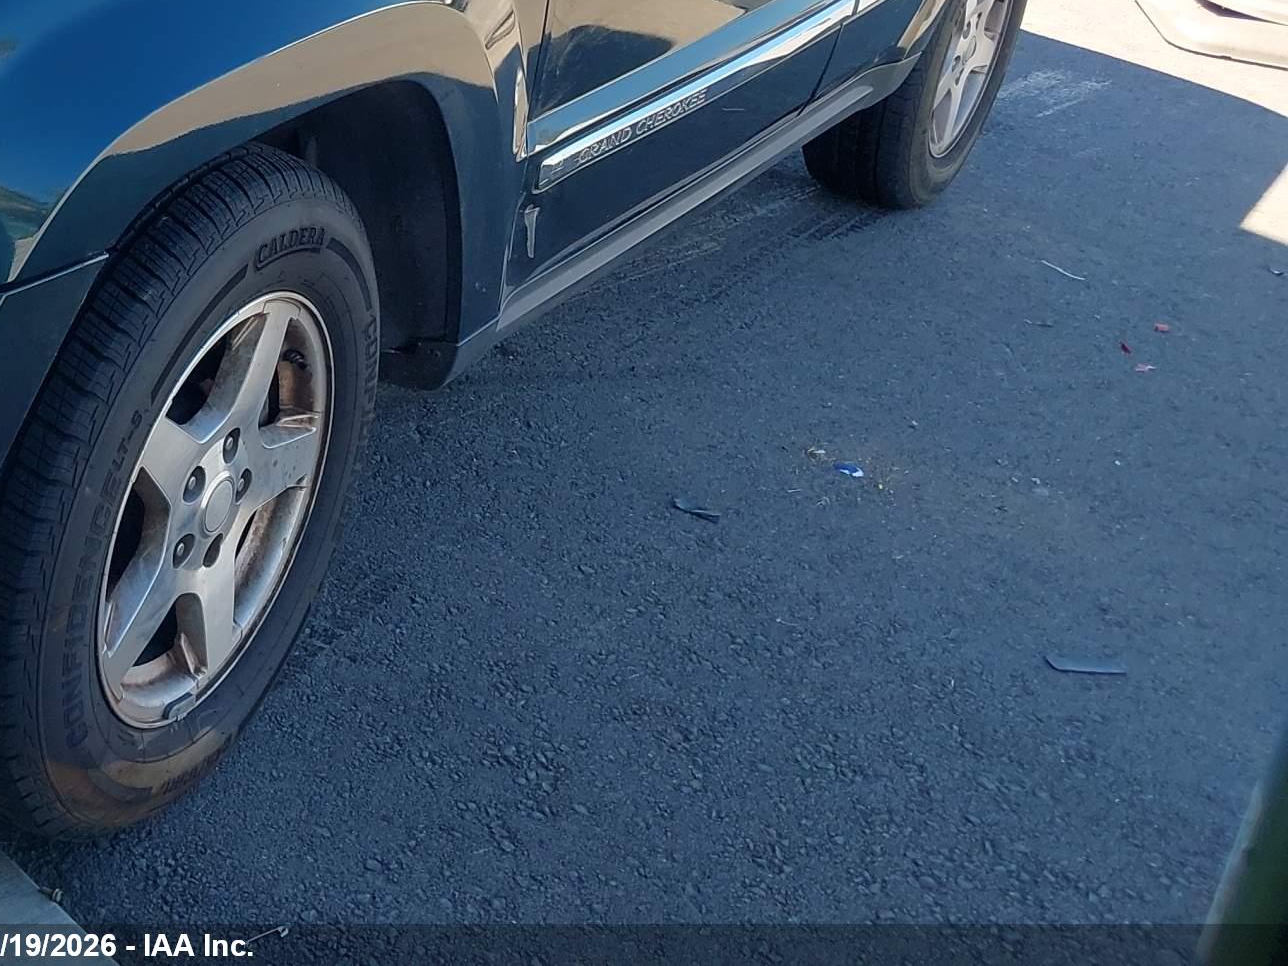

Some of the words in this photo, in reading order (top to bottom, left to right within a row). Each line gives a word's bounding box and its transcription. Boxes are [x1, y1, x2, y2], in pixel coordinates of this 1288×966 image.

[576, 127, 632, 164] GRAND
[636, 89, 709, 135] CHEROKEE
[258, 226, 325, 264] CALDERA
[63, 472, 123, 748] CONFIDENCE
